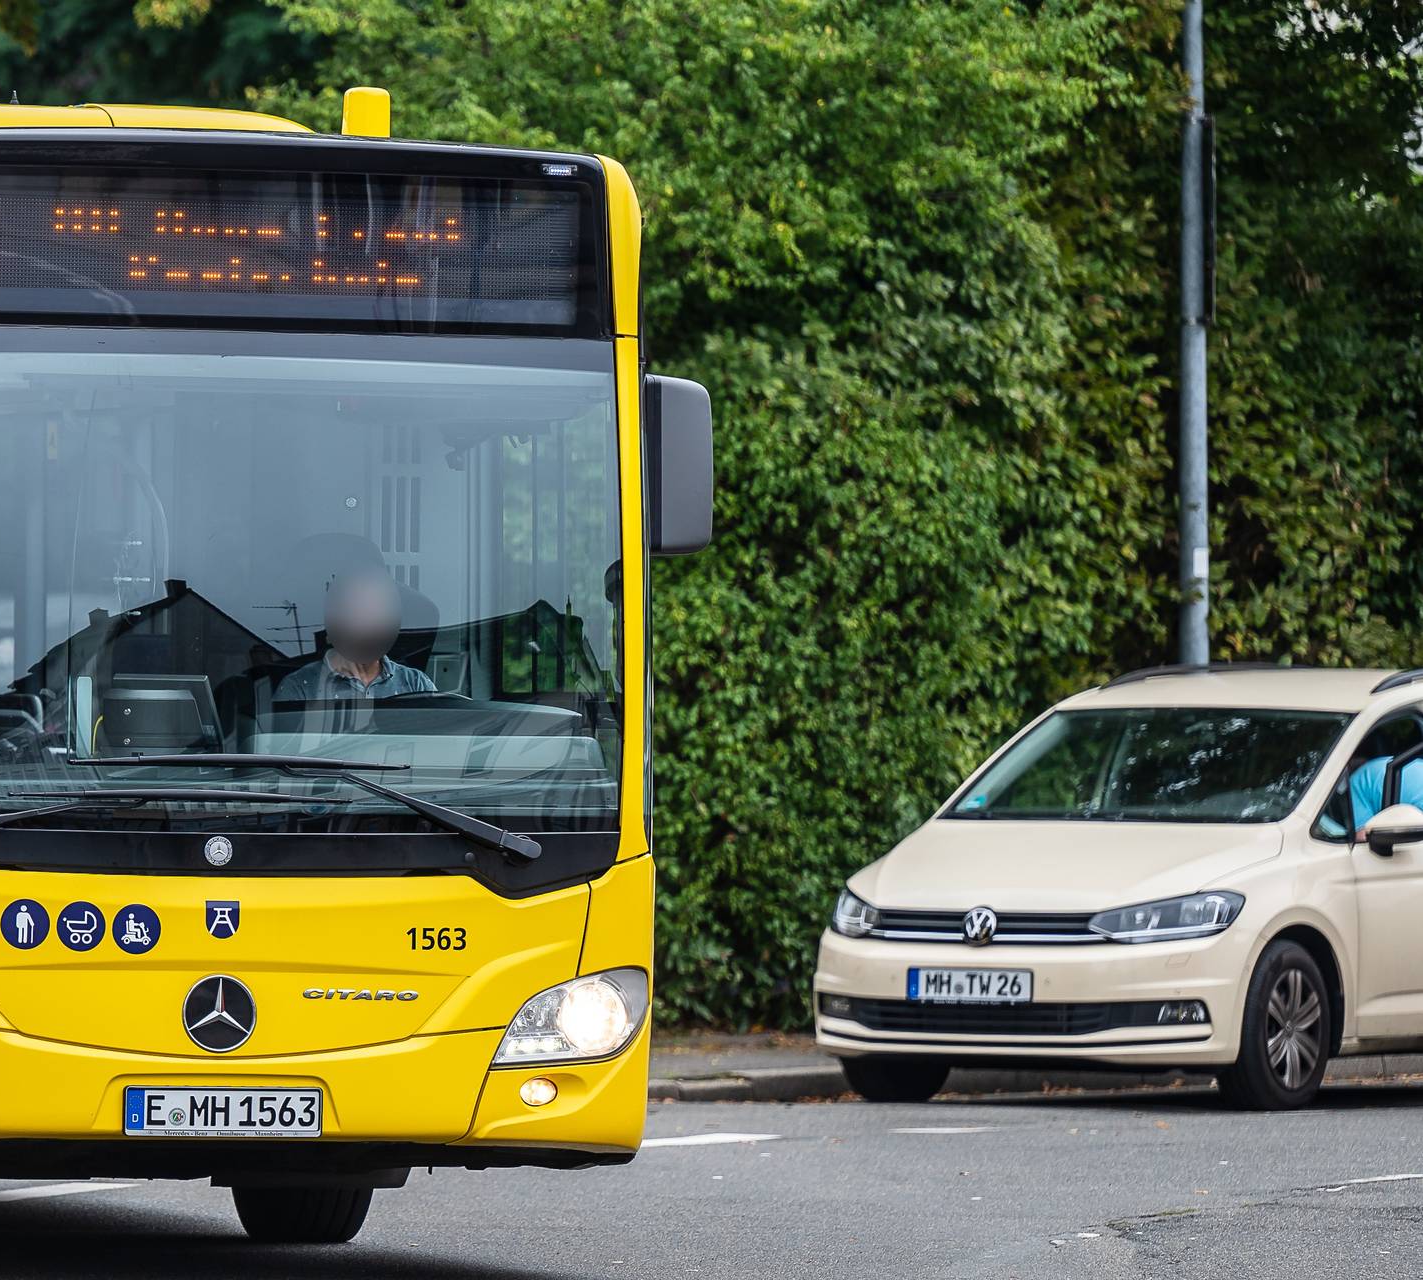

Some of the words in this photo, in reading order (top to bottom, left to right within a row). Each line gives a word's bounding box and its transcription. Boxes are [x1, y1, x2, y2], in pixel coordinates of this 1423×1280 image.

[406, 927, 467, 951] 1563
[302, 988, 419, 1002] CITARO
[925, 973, 952, 995] MH
[965, 973, 992, 995] TW
[997, 974, 1022, 996] 26
[131, 1114, 139, 1123] D
[146, 1095, 166, 1126] E
[189, 1095, 230, 1127] MH
[238, 1096, 316, 1127] 1563
